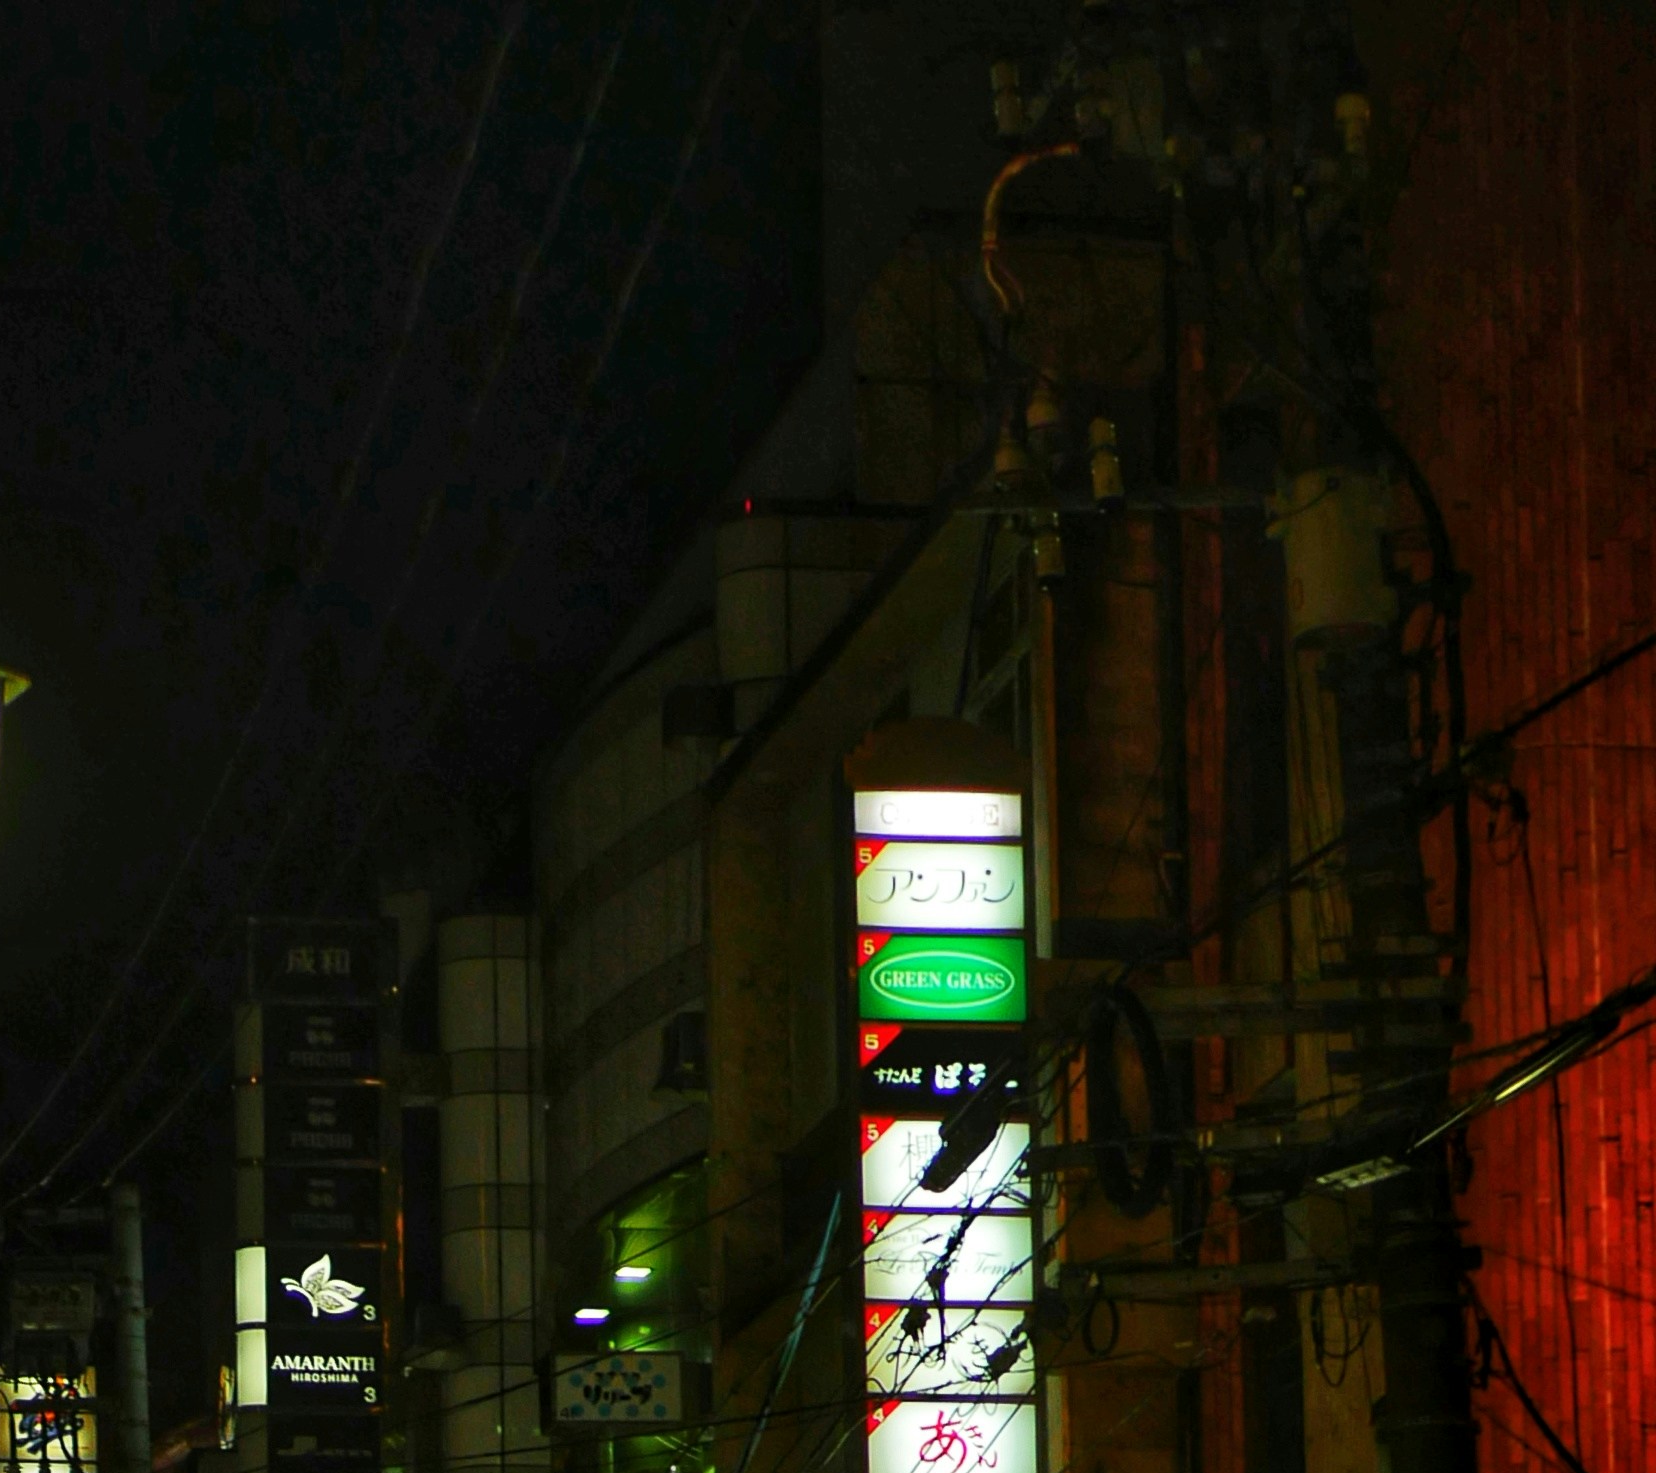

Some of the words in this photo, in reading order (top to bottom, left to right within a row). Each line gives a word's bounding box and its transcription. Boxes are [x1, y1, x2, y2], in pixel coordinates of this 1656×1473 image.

[859, 847, 872, 862] 5
[863, 940, 875, 954] 5
[879, 971, 942, 989] GREEN
[946, 971, 1006, 989] GRASS
[865, 1035, 879, 1049] 5
[867, 1124, 879, 1141] 5
[363, 1304, 376, 1321] 3
[271, 1355, 375, 1372] AMARANTH
[291, 1373, 359, 1384] HIROSHIMA
[363, 1387, 376, 1403] 3
